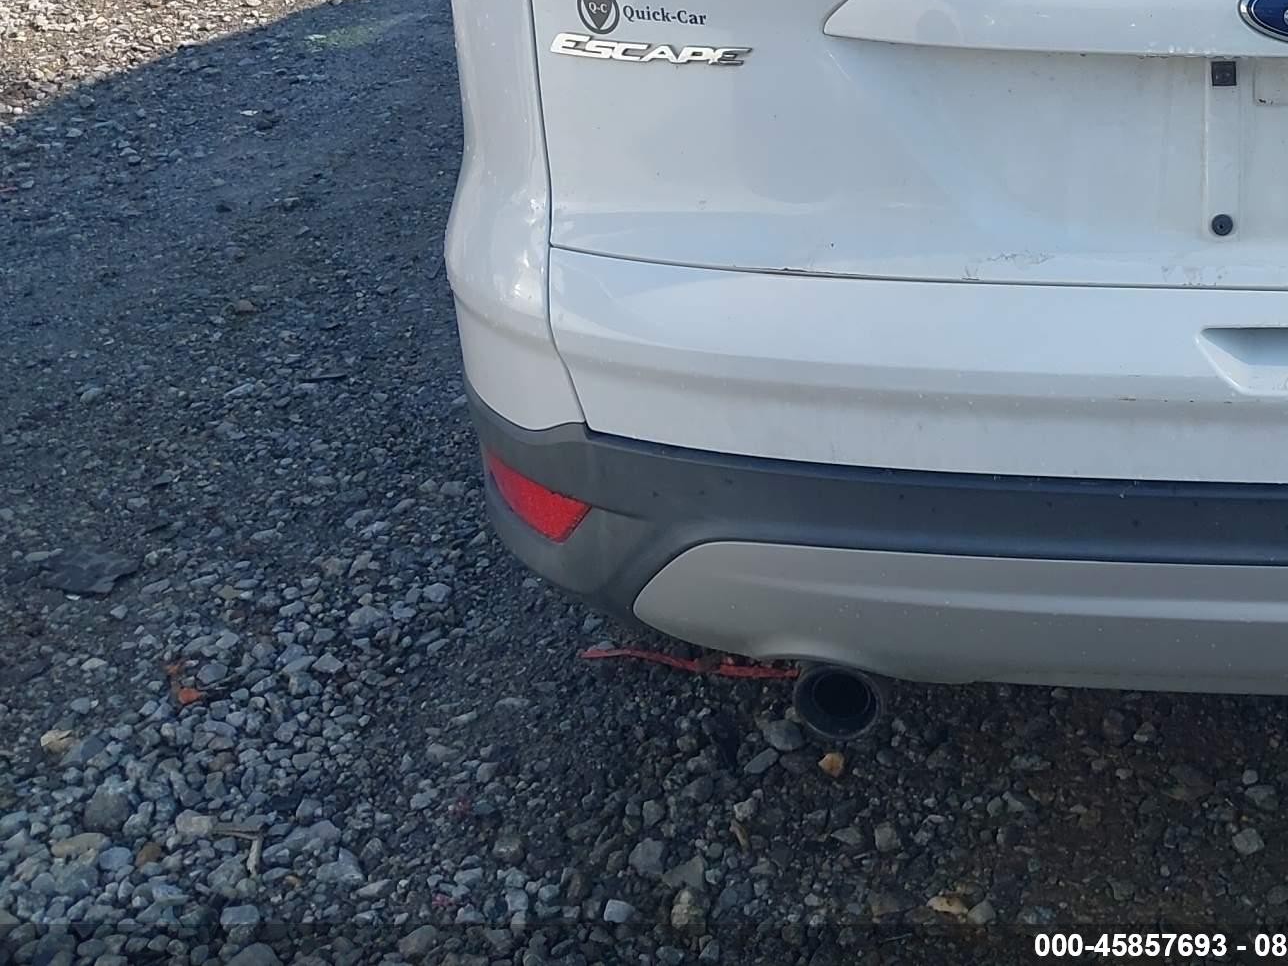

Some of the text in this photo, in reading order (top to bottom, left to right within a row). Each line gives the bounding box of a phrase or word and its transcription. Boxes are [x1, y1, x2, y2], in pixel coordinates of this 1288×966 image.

[588, 1, 608, 14] Q-C
[622, 5, 707, 25] Quick-Car
[550, 32, 753, 66] ESCAPE
